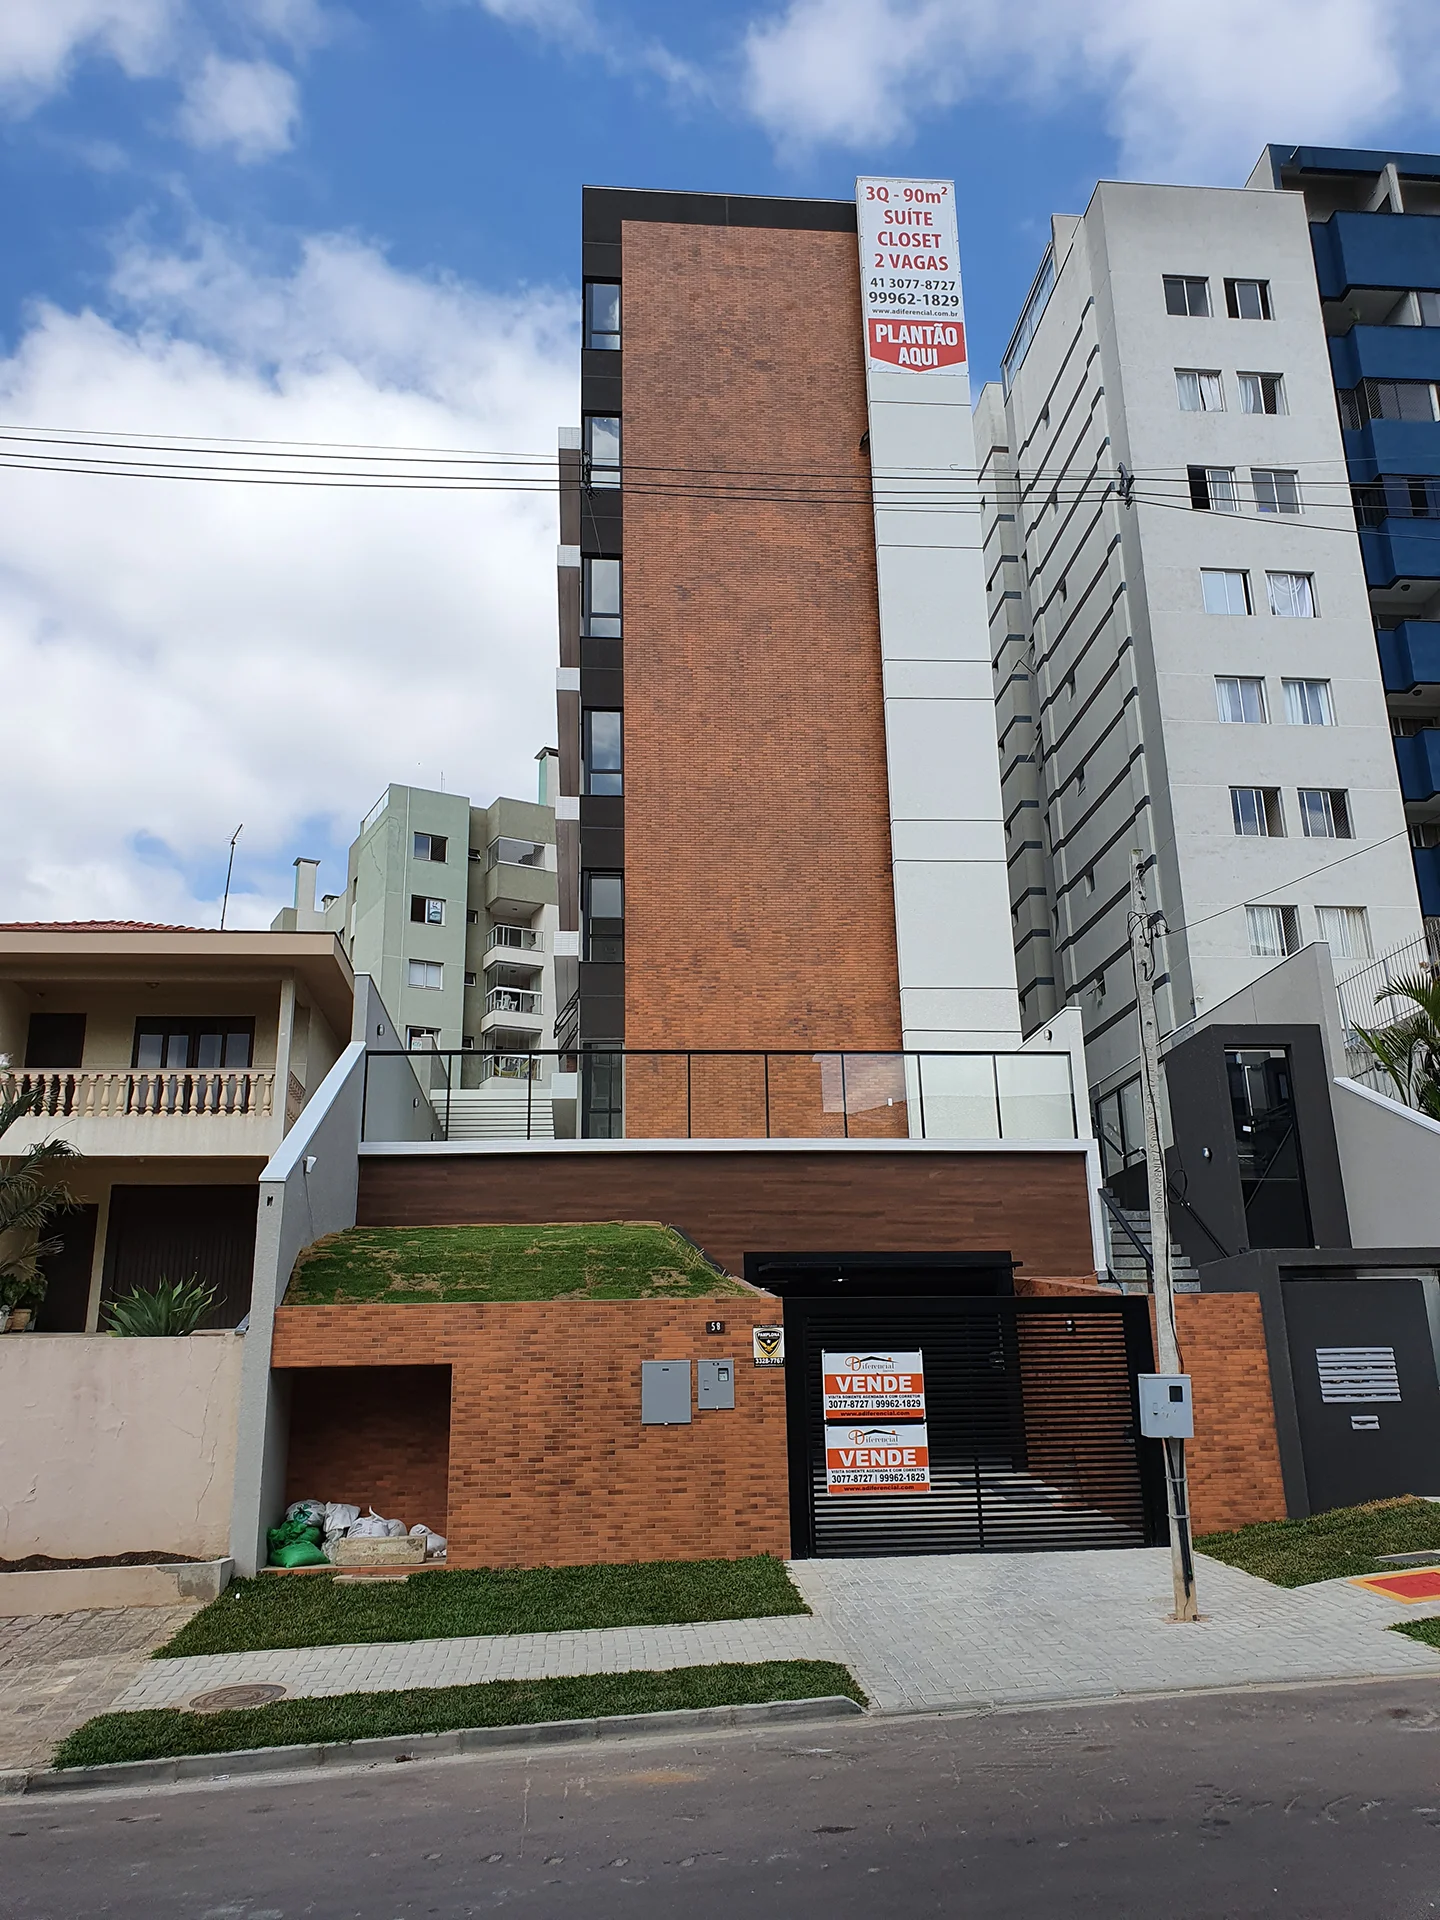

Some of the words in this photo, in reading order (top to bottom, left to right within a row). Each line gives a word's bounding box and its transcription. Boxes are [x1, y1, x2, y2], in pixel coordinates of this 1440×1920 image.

[866, 186, 889, 203] 3Q
[884, 208, 933, 226] SUÍTE
[877, 231, 942, 248] CLOSET
[874, 253, 885, 268] 2
[889, 253, 949, 271] VAGAS
[870, 278, 885, 288] 41
[889, 279, 956, 291] 3077-8727
[868, 291, 959, 307] 99962-1829
[872, 308, 958, 317] www.adiferencial.com.br
[875, 323, 958, 346] PLANTÃO
[898, 346, 938, 366] AQUI
[711, 1322, 721, 1331] 58
[845, 1356, 895, 1371] Diferencial
[835, 1375, 913, 1393] VENDE
[828, 1400, 869, 1408] 3077-8727
[875, 1400, 921, 1408] 99962-1829
[848, 1429, 898, 1445] Diferencial
[838, 1449, 917, 1467] VENDE
[831, 1474, 873, 1483] 3077-8727
[879, 1473, 926, 1482] 99962-1829
